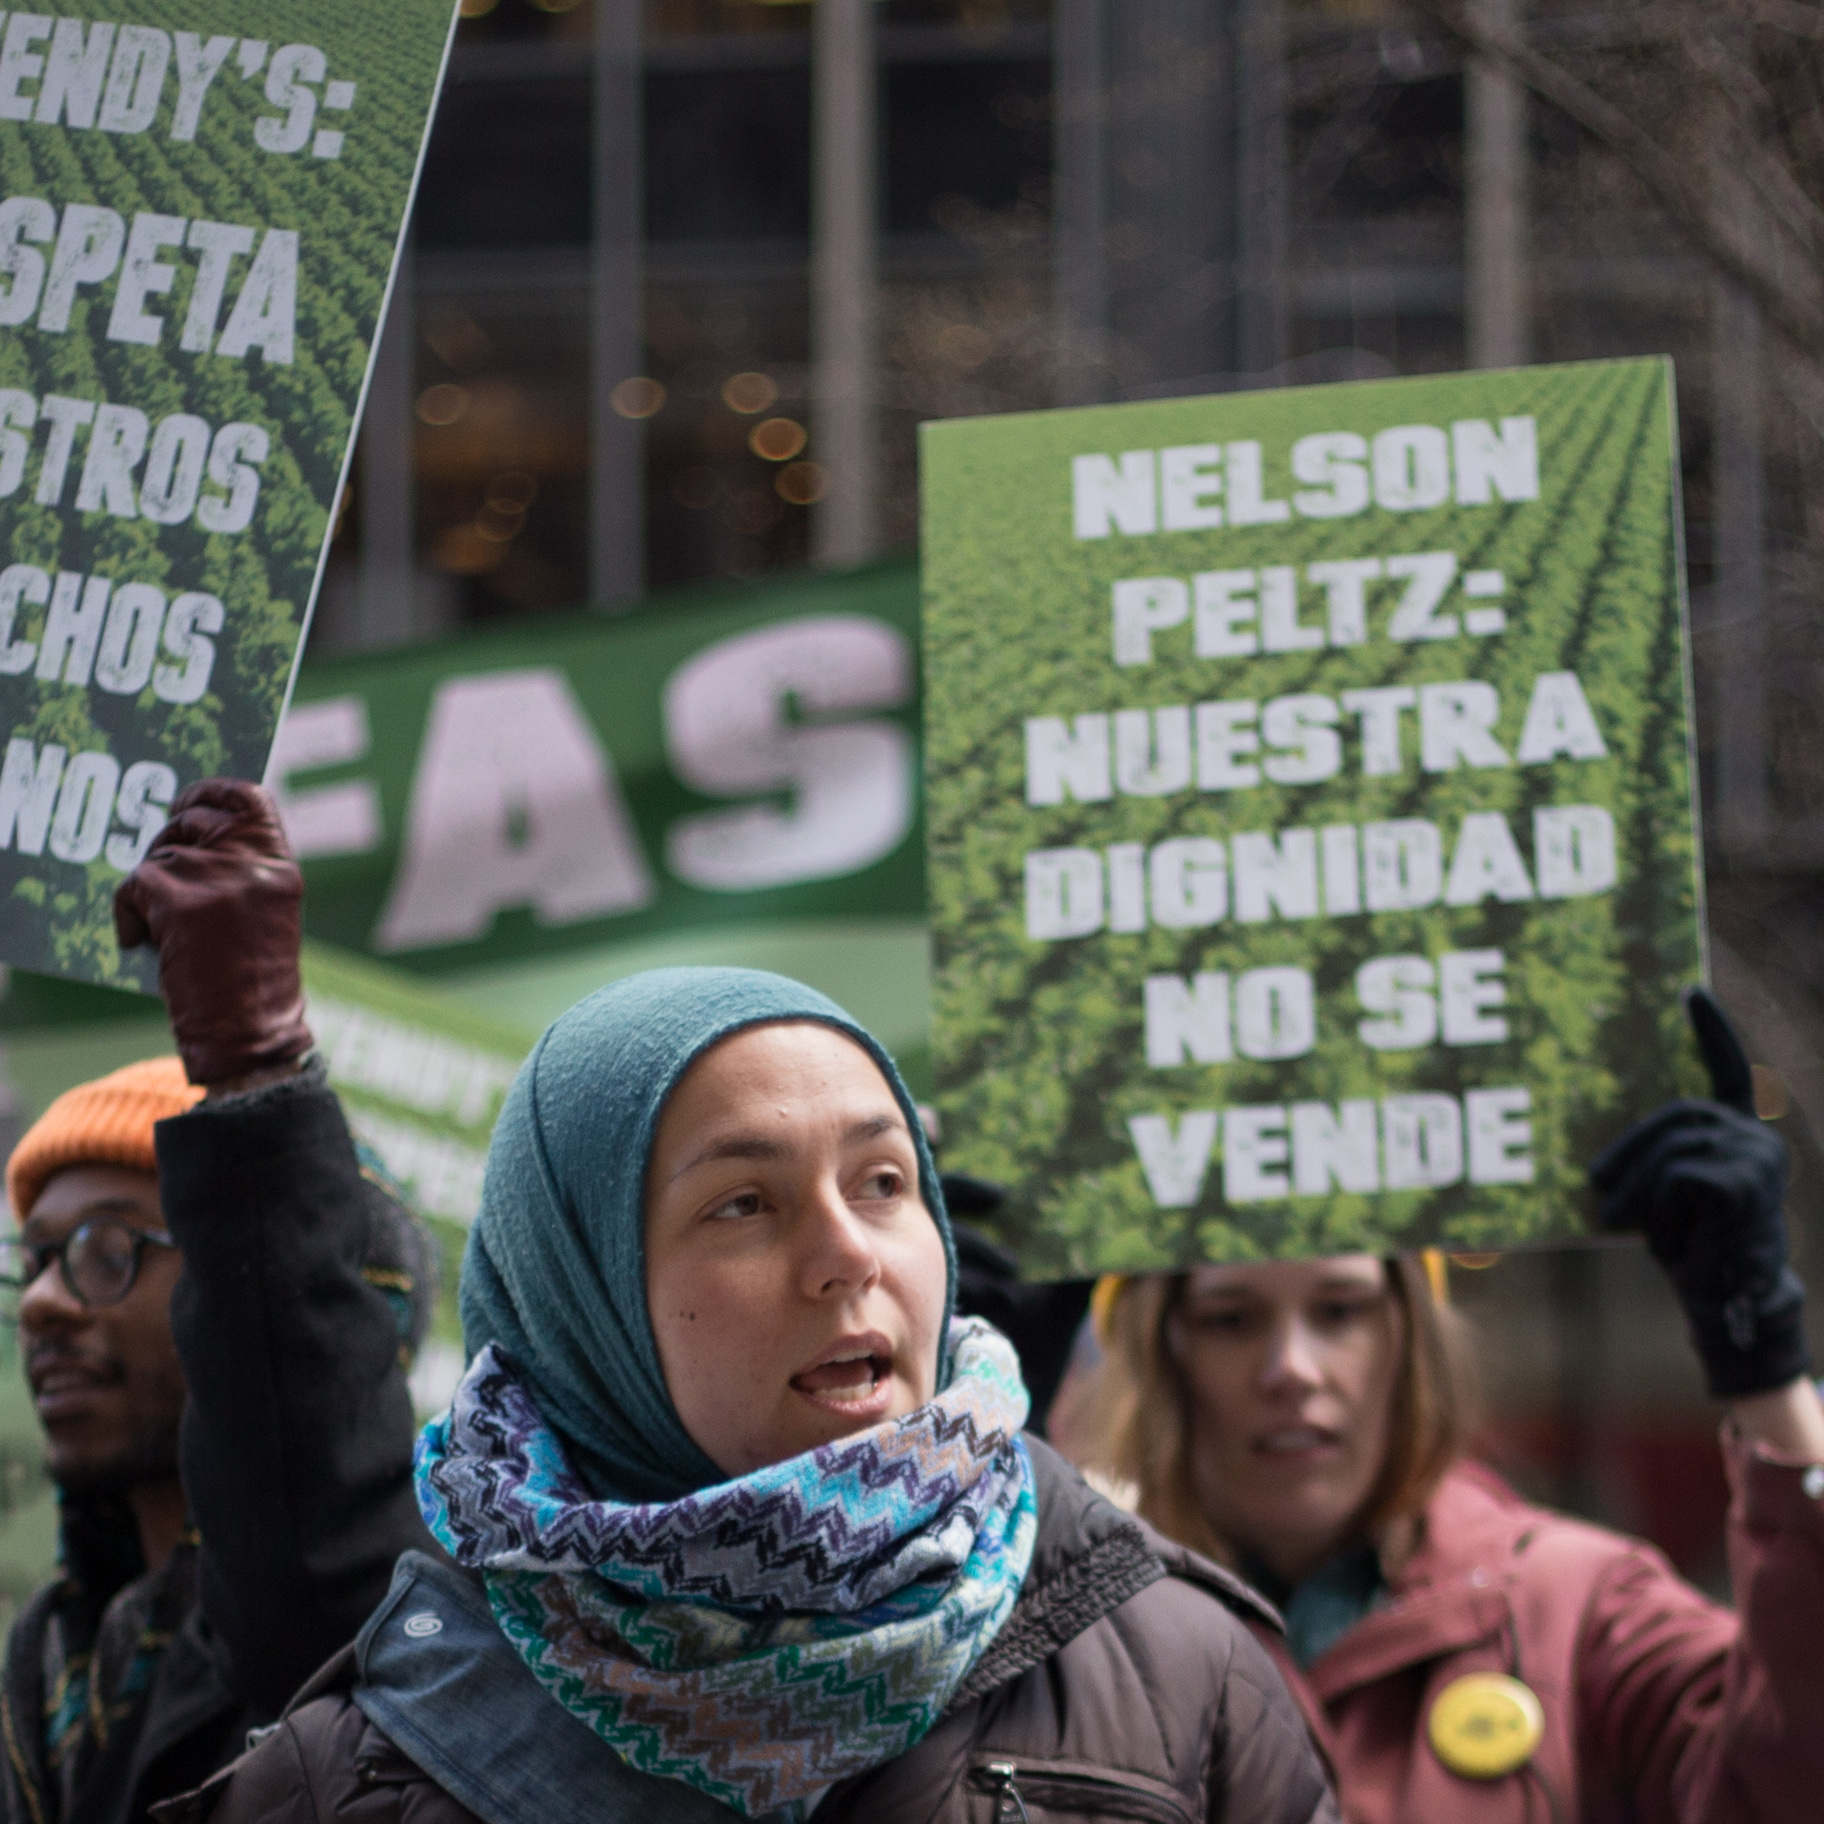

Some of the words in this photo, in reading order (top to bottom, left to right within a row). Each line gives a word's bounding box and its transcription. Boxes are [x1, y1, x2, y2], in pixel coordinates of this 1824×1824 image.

[1071, 415, 1539, 540] NELSON
[1112, 551, 1507, 667] PELTZ:
[1024, 671, 1607, 805] NUESTRA
[1024, 805, 1619, 942] DIGNIDAD
[1143, 965, 1316, 1069] NO
[1356, 948, 1509, 1050] SE
[1128, 1086, 1535, 1207] VENDE
